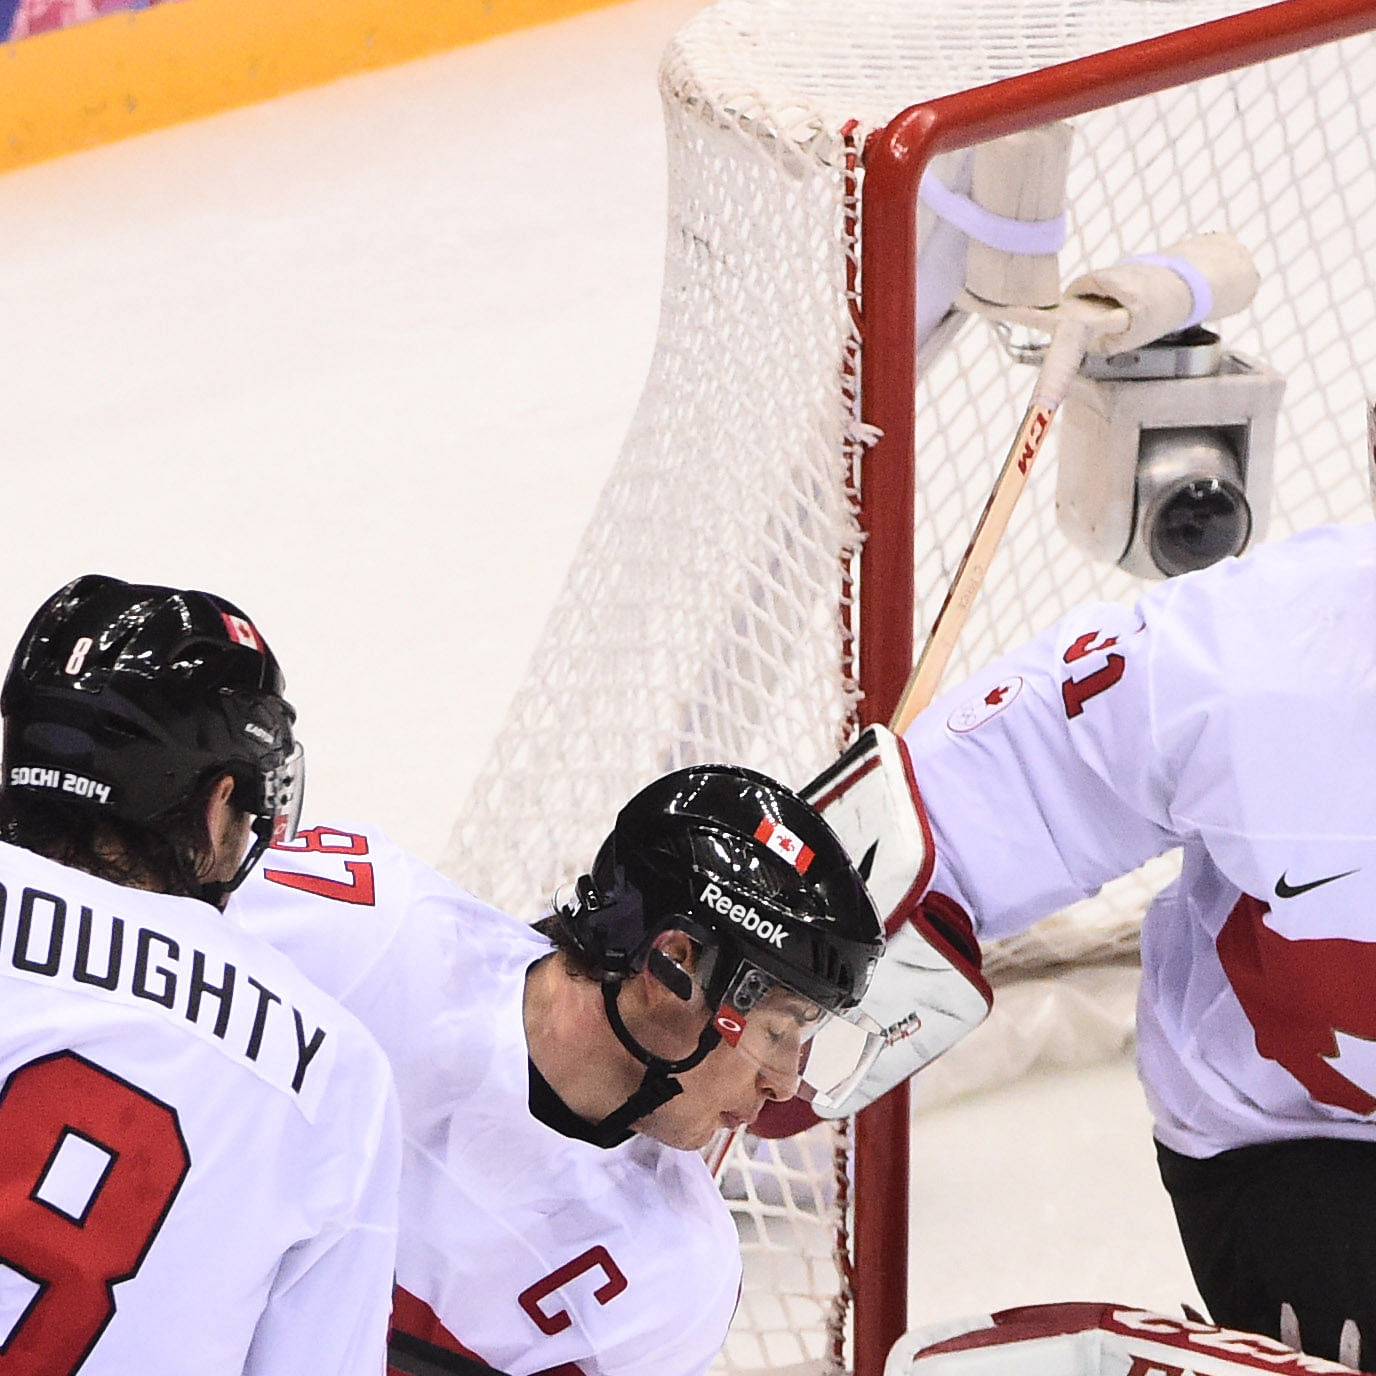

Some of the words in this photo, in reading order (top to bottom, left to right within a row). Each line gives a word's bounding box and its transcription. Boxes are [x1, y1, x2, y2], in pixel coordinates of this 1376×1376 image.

[1016, 408, 1054, 477] CM
[64, 636, 94, 676] 8
[10, 766, 61, 789] SOCHI
[62, 773, 112, 803] 2014
[262, 825, 376, 908] 87
[699, 882, 791, 949] Reebok
[517, 1244, 628, 1336] C
